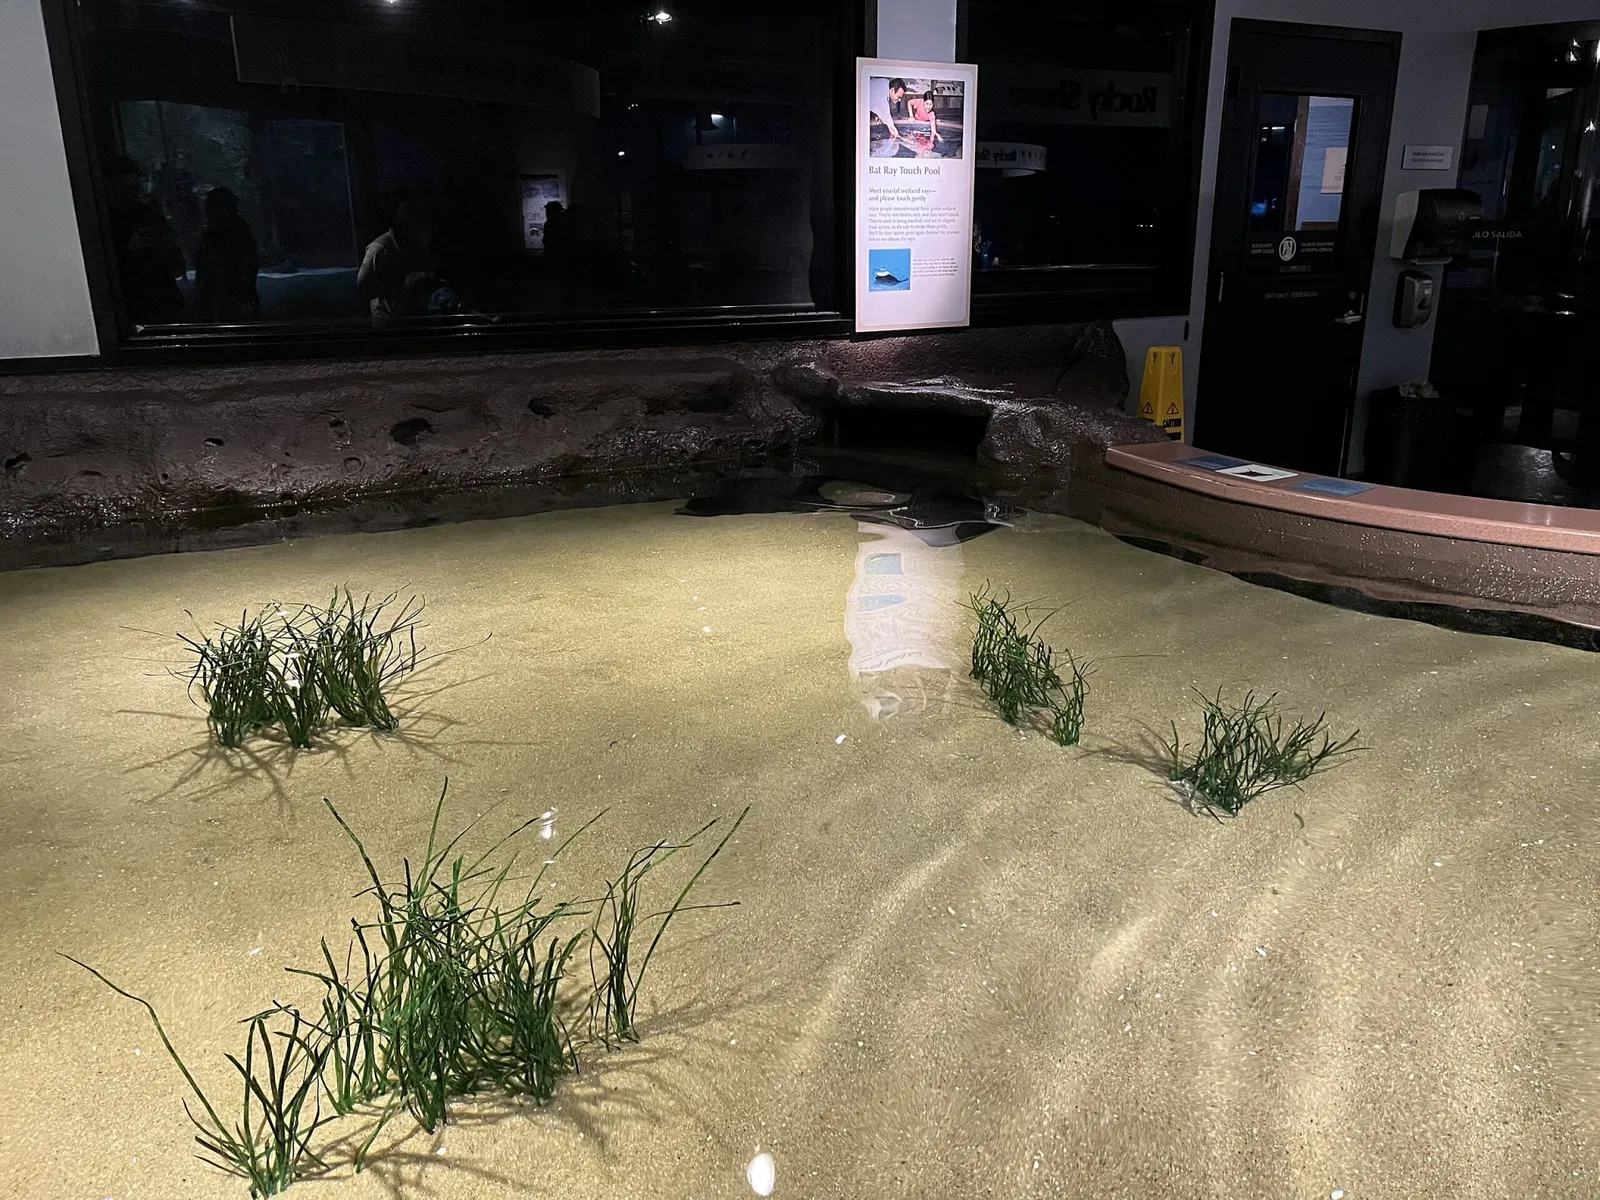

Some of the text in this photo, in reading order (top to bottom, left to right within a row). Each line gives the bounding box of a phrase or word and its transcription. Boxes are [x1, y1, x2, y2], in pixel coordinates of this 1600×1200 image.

[869, 166, 941, 177] Bat Ray Touch Pool
[879, 195, 896, 203] please
[911, 195, 927, 203] gently
[1490, 230, 1522, 239] SALIDA
